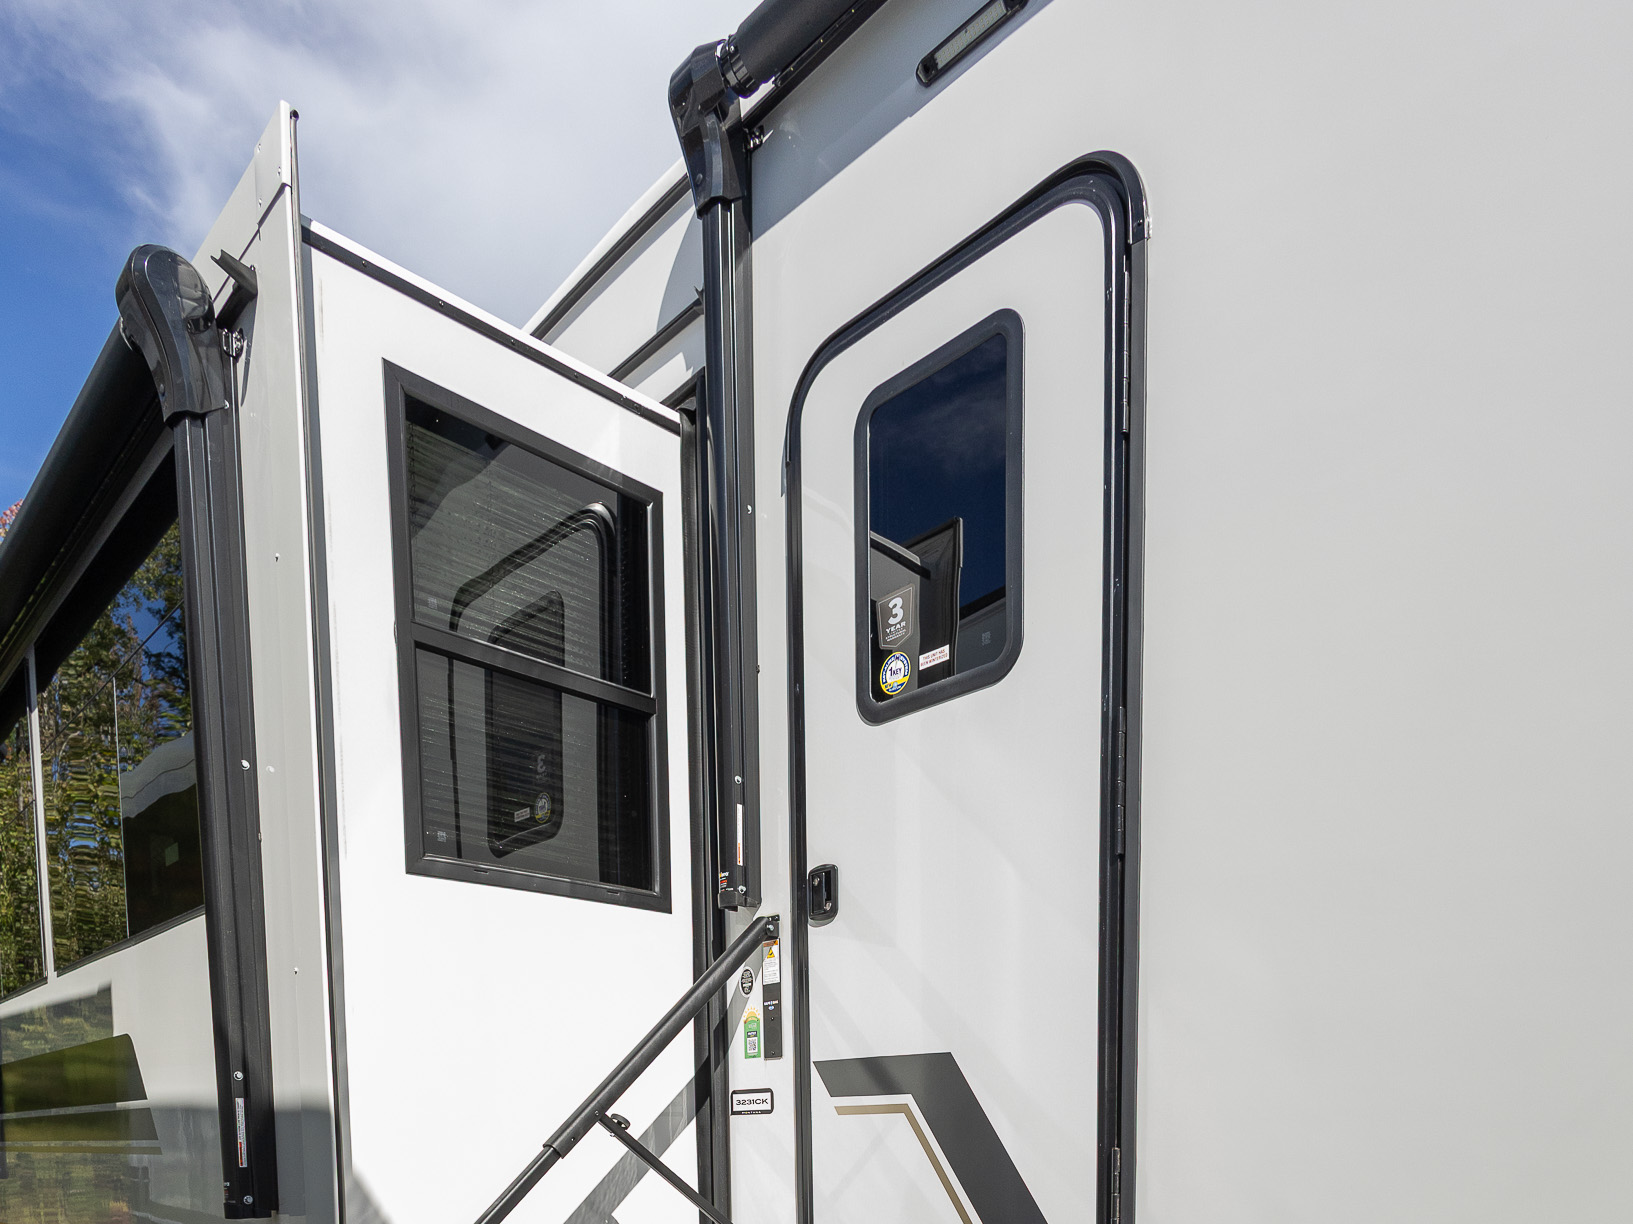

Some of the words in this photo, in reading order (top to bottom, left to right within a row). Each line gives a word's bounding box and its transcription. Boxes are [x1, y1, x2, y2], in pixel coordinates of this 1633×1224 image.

[888, 597, 904, 625] 3
[886, 621, 906, 634] YEAR
[735, 1098, 769, 1106] 3231CK
